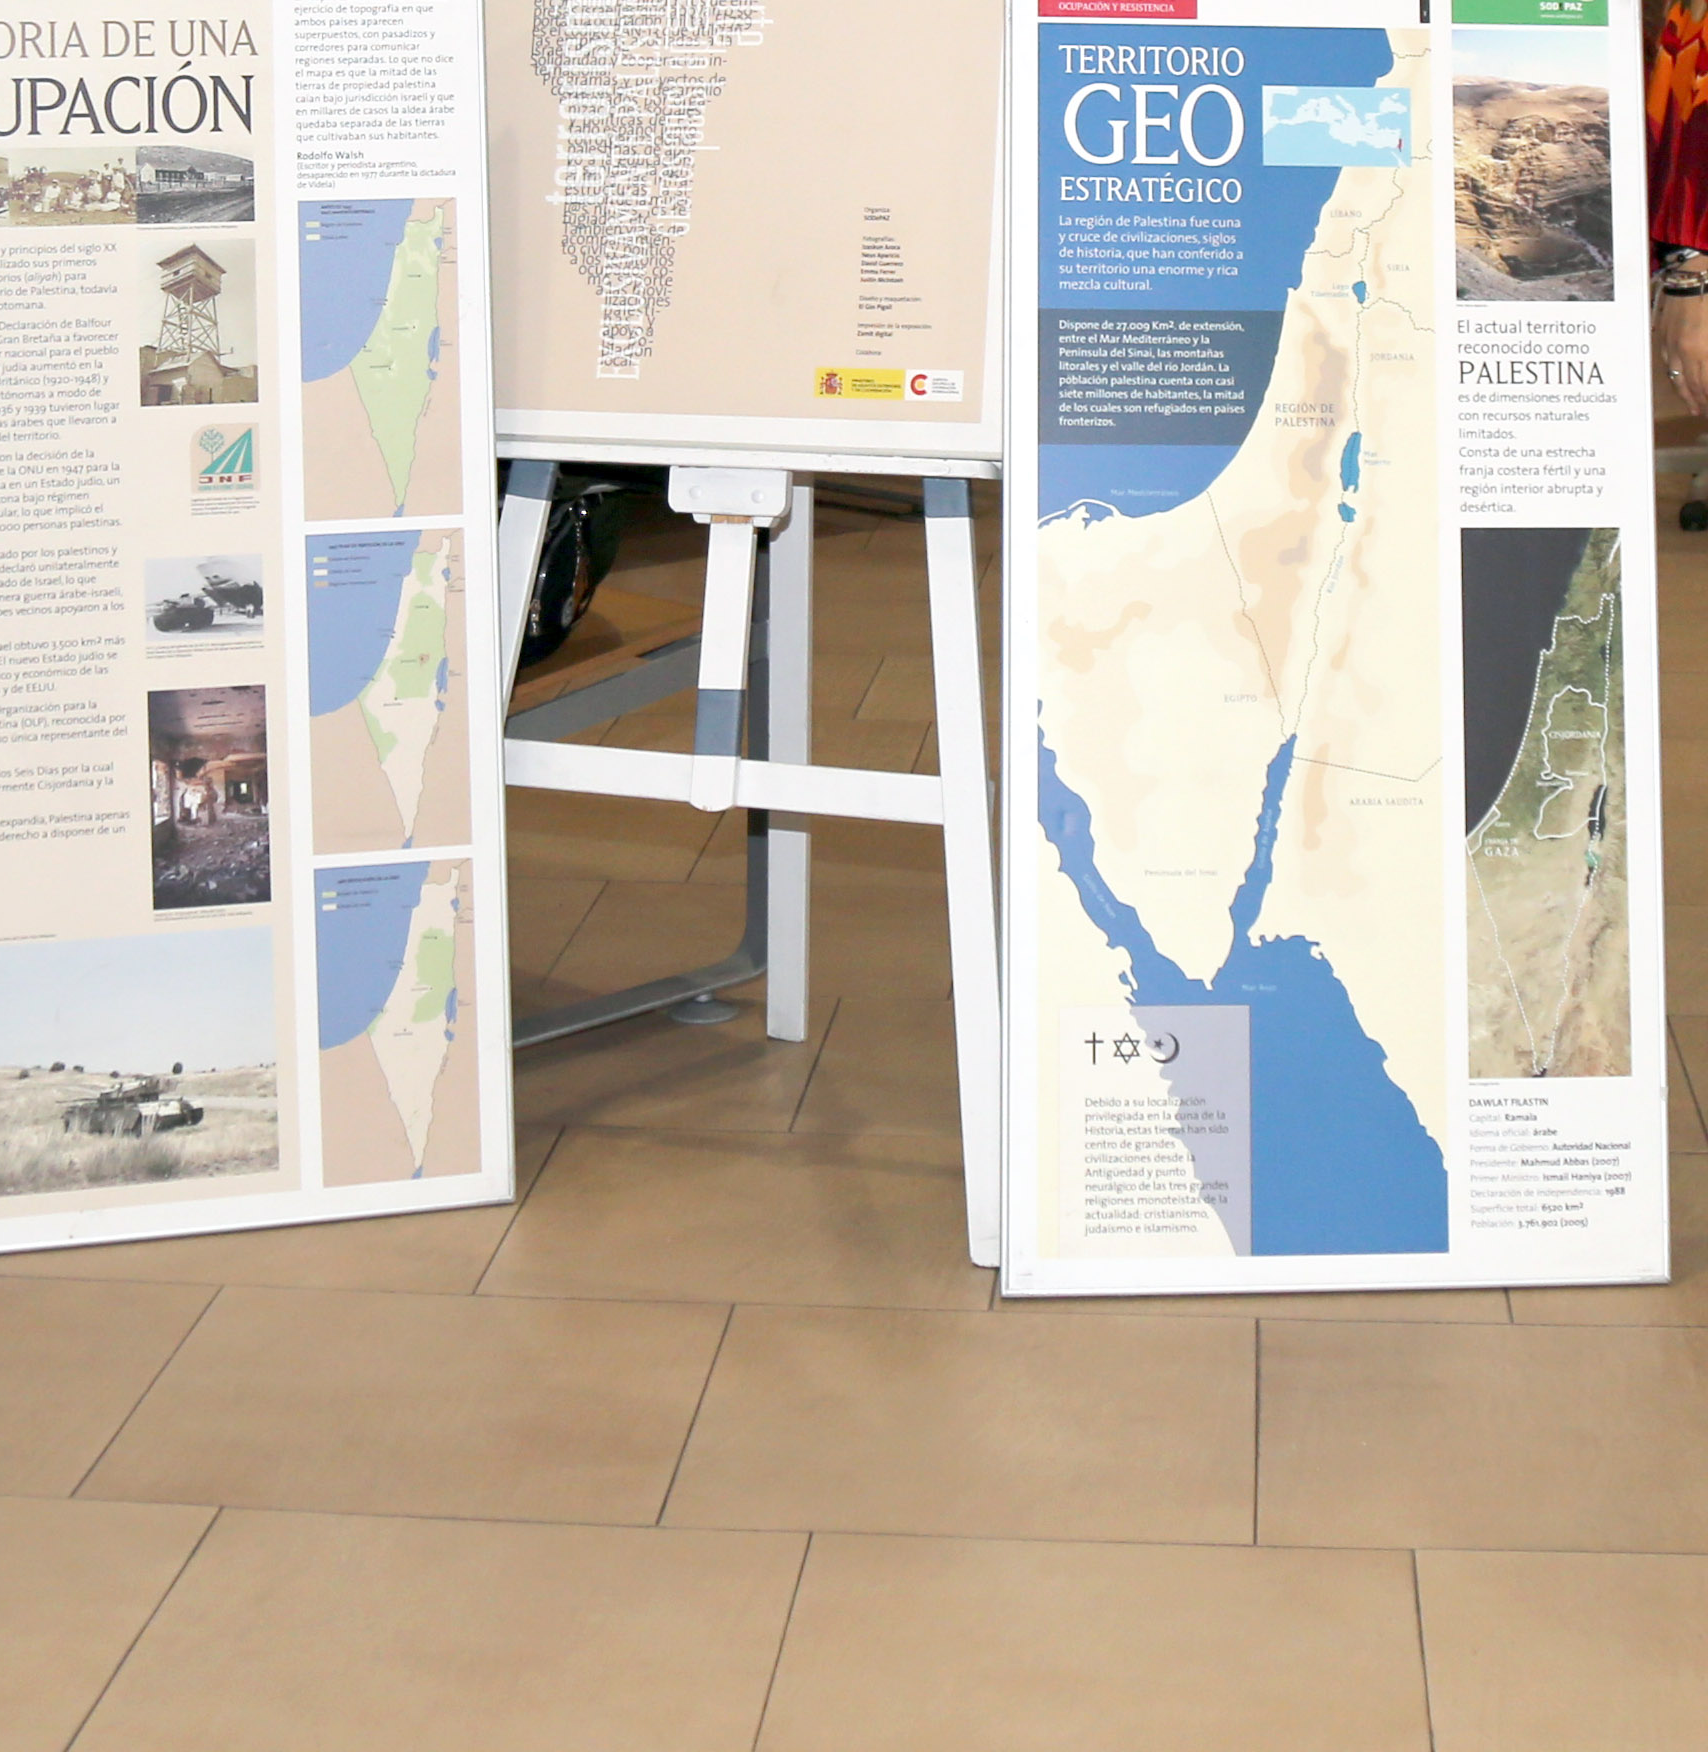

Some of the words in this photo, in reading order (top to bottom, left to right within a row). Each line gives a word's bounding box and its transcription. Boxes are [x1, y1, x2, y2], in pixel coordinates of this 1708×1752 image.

[294, 6, 333, 16] ejercicio
[335, 5, 347, 13] de
[415, 5, 434, 15] que
[1058, 2, 1110, 11] OCUPACIÓN
[1112, 3, 1118, 11] Y
[1120, 3, 1175, 12] RESISTENCIA
[294, 18, 326, 26] ambos
[361, 19, 404, 28] aparecen
[102, 20, 155, 57] DE
[168, 20, 258, 57] UNA
[1058, 45, 1244, 76] TERRITORIO
[1064, 84, 1244, 165] GEO
[297, 151, 333, 160] Rodolfo
[335, 151, 364, 159] Walsh
[1060, 173, 1242, 203] ESTRATÉGICO
[1059, 215, 1072, 226] La
[1075, 216, 1113, 230] región
[1115, 216, 1131, 226] de
[1133, 216, 1187, 227] Palestina
[1189, 217, 1210, 228] fue
[1212, 219, 1241, 228] cuna
[1058, 233, 1066, 245] y
[1068, 233, 1101, 242] cruce
[1103, 232, 1118, 242] de
[1120, 232, 1201, 244] civilizaciones,
[1202, 233, 1236, 247] siglos
[1, 248, 7, 256] y
[9, 245, 58, 256] principios
[59, 243, 75, 253] del
[77, 243, 101, 254] siglo
[103, 243, 117, 252] XX
[1059, 248, 1074, 258] de
[1077, 248, 1125, 259] historia,
[1126, 250, 1150, 261] que
[1152, 248, 1175, 259] han
[1178, 249, 1234, 260] conferido
[1236, 251, 1243, 260] a
[1059, 265, 1073, 274] su
[1075, 264, 1130, 274] territorio
[1132, 266, 1156, 274] una
[1158, 266, 1205, 276] enorme
[1206, 267, 1215, 279] y
[1216, 266, 1238, 276] rica
[1059, 280, 1100, 290] mezcla
[1103, 280, 1153, 290] cultural.
[1457, 320, 1470, 334] El
[1475, 320, 1522, 334] actual
[1526, 321, 1596, 334] territorio
[1458, 341, 1543, 354] reconocido
[1547, 344, 1590, 355] como
[1370, 353, 1414, 362] JORDANIA
[1460, 361, 1604, 384] PALESTINA
[1458, 394, 1470, 403] es
[1472, 392, 1487, 403] de
[1489, 392, 1561, 403] dimensiones
[1563, 392, 1617, 403] reducidas
[1275, 399, 1318, 414] REGIÓN
[1320, 403, 1334, 413] DE
[1458, 412, 1479, 421] con
[1482, 412, 1532, 421] recursos
[1535, 410, 1590, 421] naturales
[1275, 417, 1335, 428] PALESTINA
[1459, 428, 1516, 439] limitados.
[1459, 447, 1500, 457] Consta
[1503, 447, 1517, 457] de
[1521, 449, 1543, 457] una
[1546, 447, 1595, 458] estrecha
[1459, 465, 1494, 479] franja
[1497, 466, 1540, 476] costera
[1543, 465, 1571, 476] fértil
[1574, 468, 1581, 479] y
[1584, 467, 1606, 476] una
[1460, 484, 1497, 498] región
[1501, 484, 1544, 494] interior
[1547, 484, 1594, 497] abrupta
[1596, 486, 1603, 498] y
[1460, 502, 1516, 512] desértica.
[1484, 846, 1519, 857] GAZA
